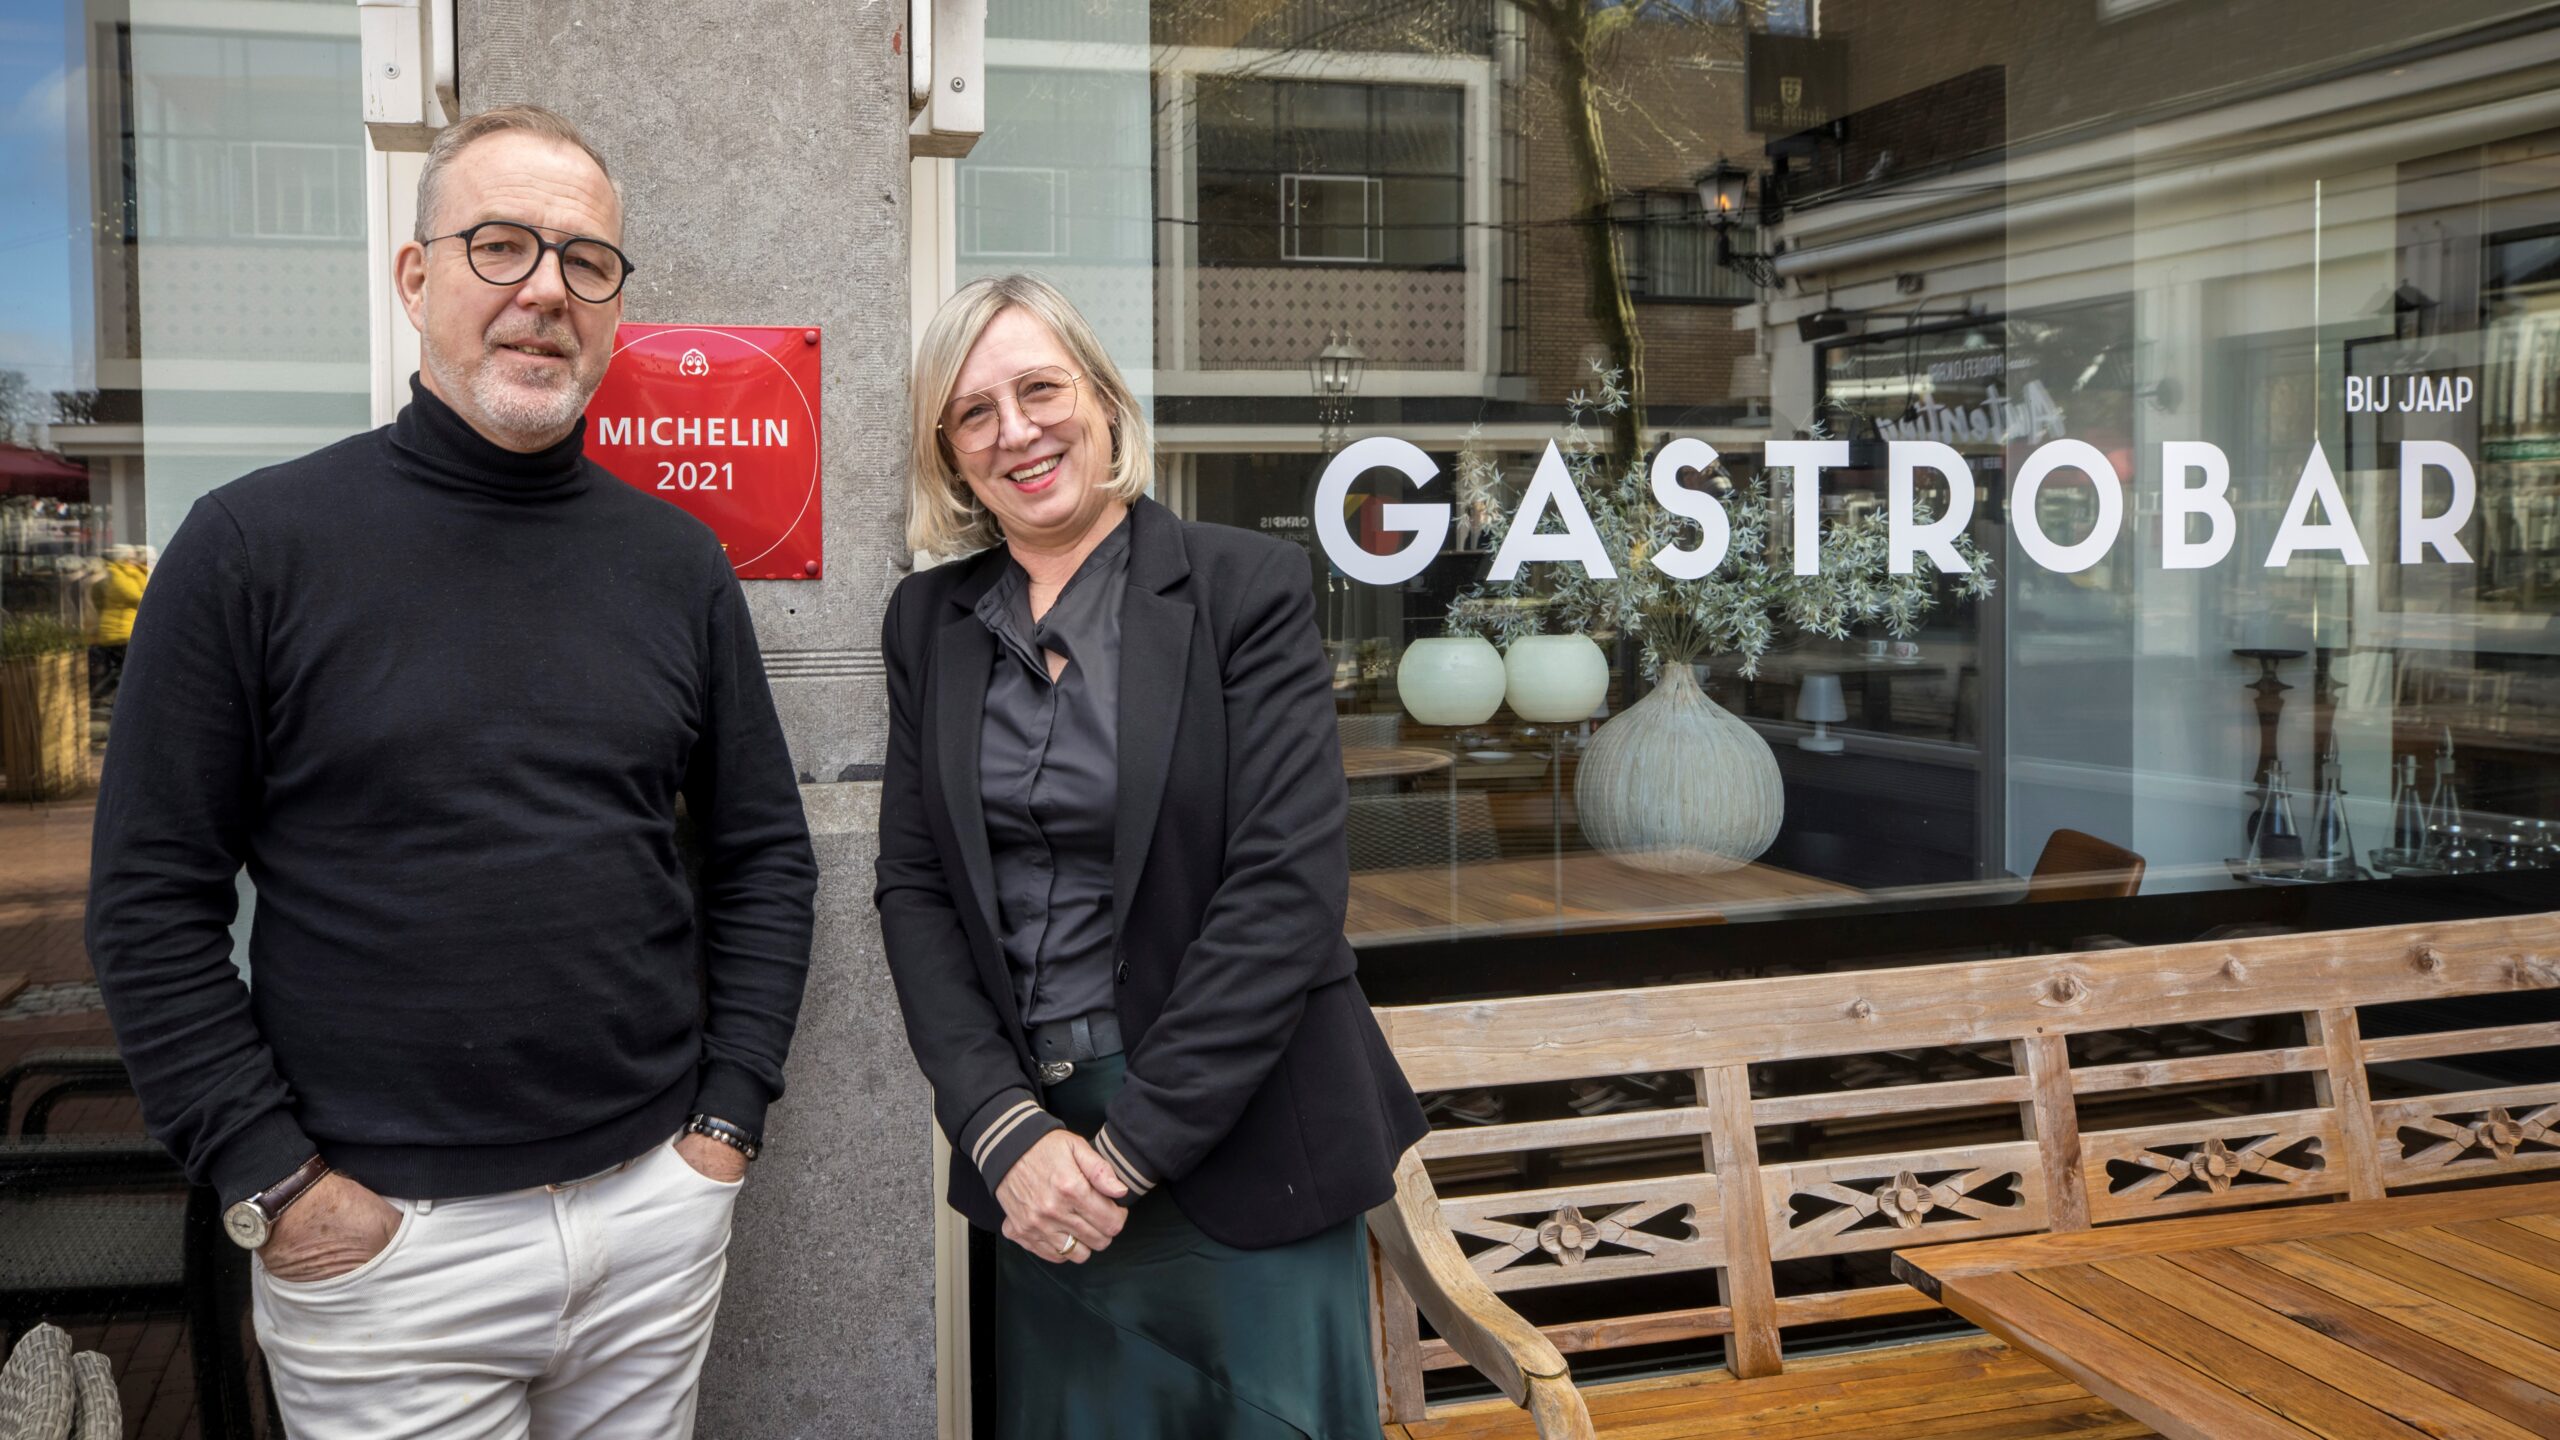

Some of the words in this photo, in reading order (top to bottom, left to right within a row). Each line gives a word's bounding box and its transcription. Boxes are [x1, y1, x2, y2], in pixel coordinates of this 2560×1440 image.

[2346, 375, 2390, 412] BIJ
[2398, 375, 2474, 412] JAAP
[599, 416, 788, 447] MICHELIN
[656, 461, 733, 491] 2021
[1314, 436, 2476, 586] GASTROBAR
